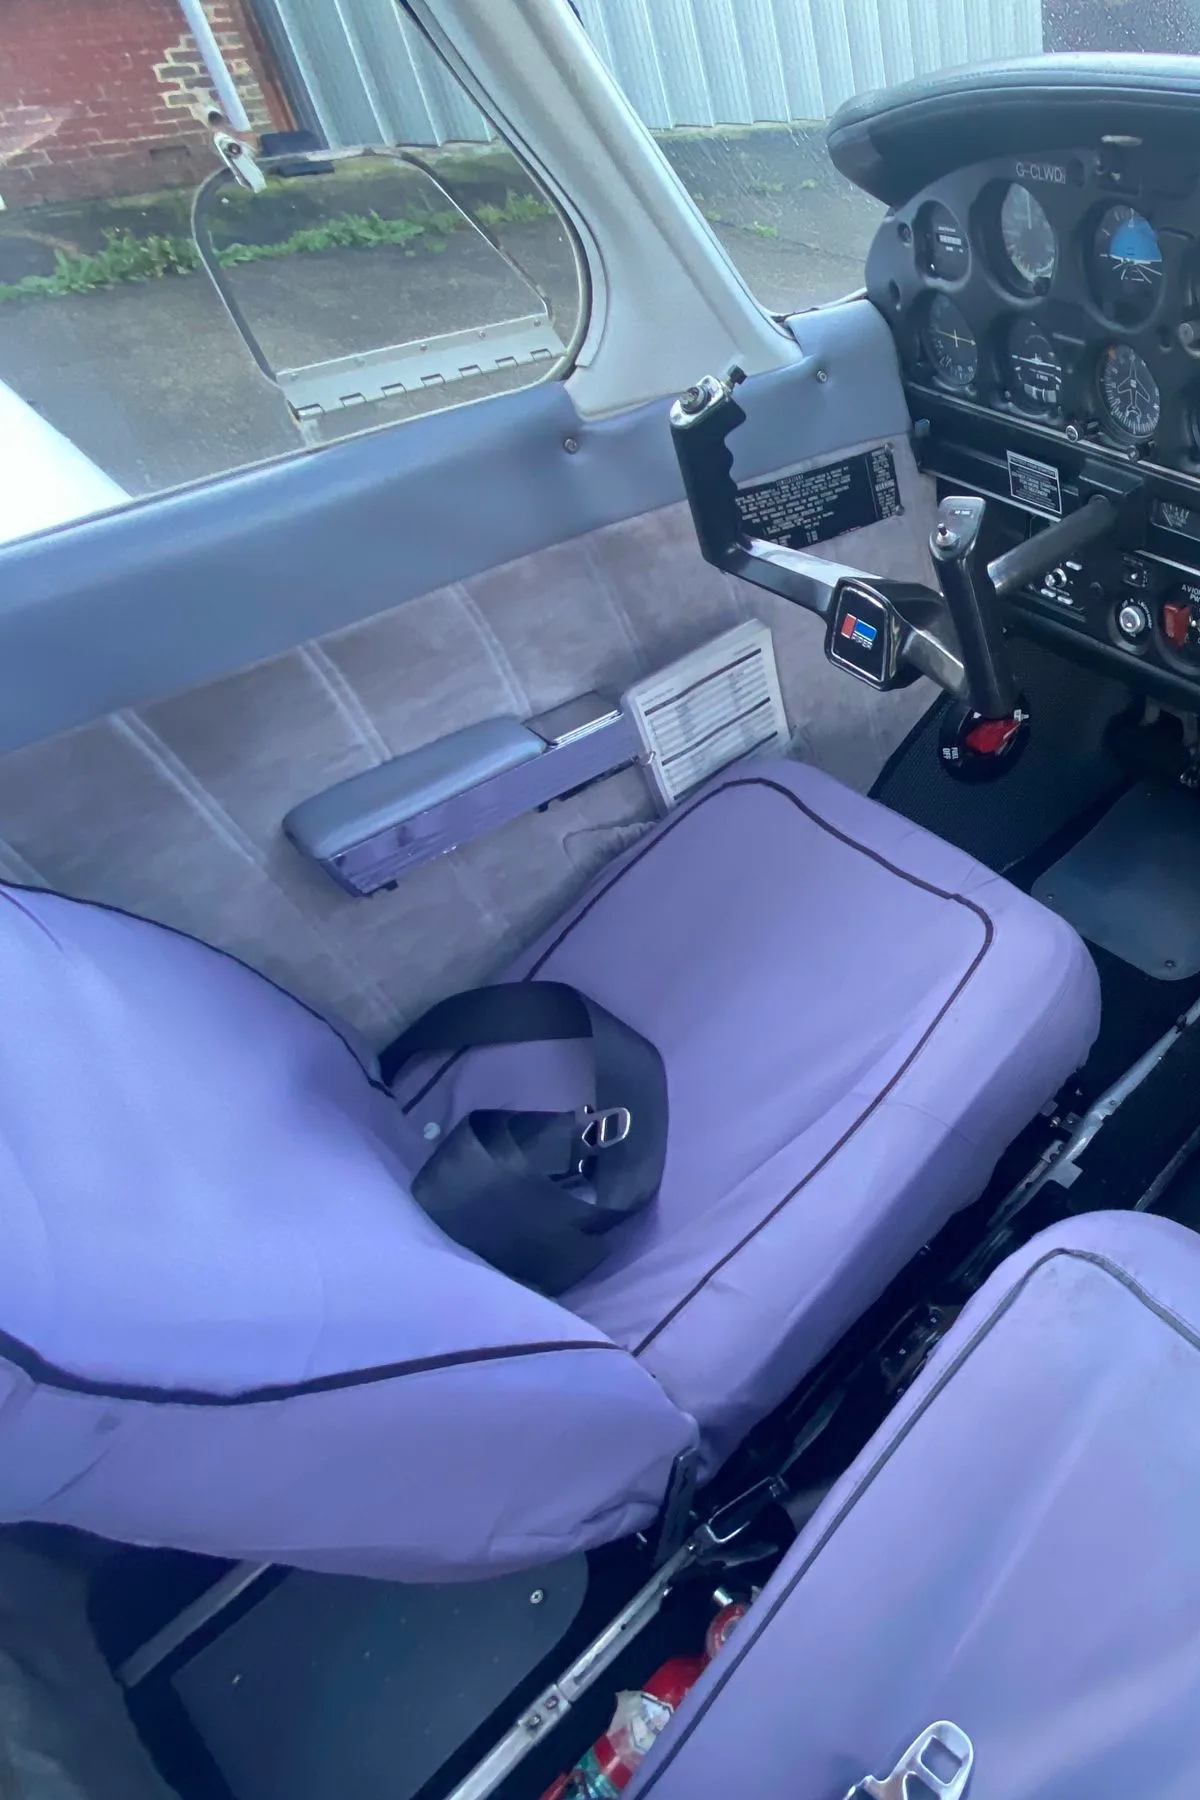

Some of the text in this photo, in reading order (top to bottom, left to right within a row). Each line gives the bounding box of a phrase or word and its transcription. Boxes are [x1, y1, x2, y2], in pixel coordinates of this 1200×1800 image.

[1016, 161, 1062, 183] G-CLWD
[851, 633, 873, 651] PIPER
[942, 747, 952, 760] OFF
[952, 746, 960, 760] FUEL
